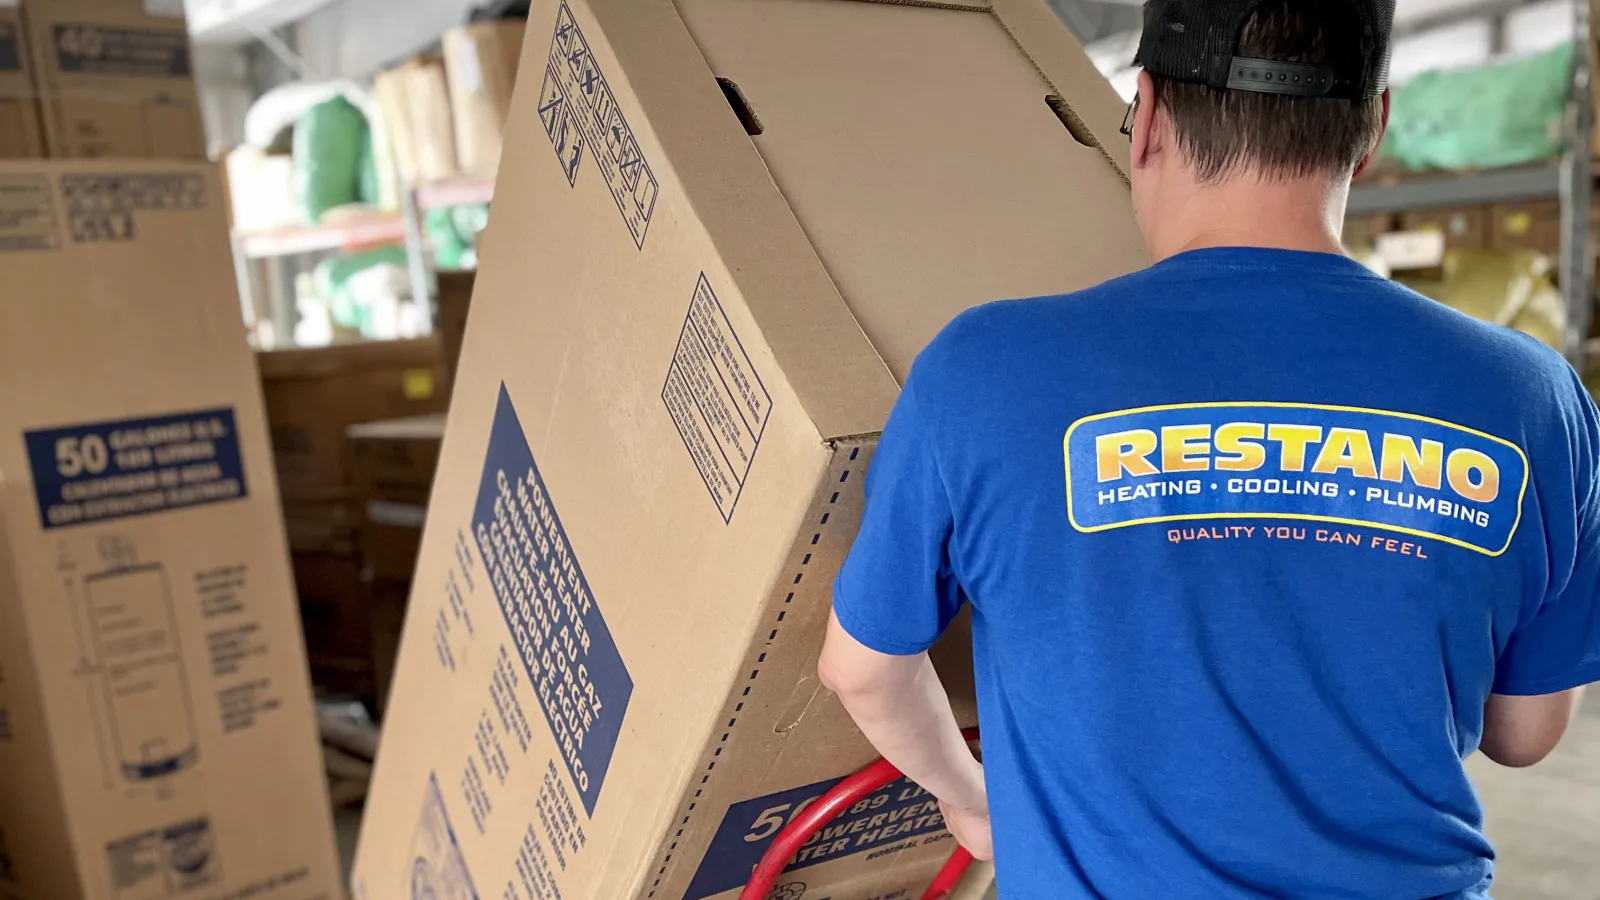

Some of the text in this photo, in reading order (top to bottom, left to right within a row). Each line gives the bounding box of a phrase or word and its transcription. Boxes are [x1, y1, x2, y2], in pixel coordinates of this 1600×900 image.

[54, 433, 109, 477] 50
[1095, 422, 1499, 503] RESTANO
[527, 468, 591, 615] POWERVENT
[1098, 479, 1489, 527] HEATING COOLING PLUMBING
[1167, 526, 1428, 559] QUALITY YOU CAN FEEL
[498, 470, 602, 719] CHAUFFE-EAU AU GAZ
[517, 478, 590, 656] WATER HEATER
[491, 522, 542, 653] CALENTADOR
[542, 648, 556, 684] DE
[555, 683, 583, 750] AGUA
[494, 497, 551, 639] ÉVACUATION
[551, 636, 592, 732] FORCÉE
[478, 523, 495, 569] CON
[493, 565, 540, 681] EXTRACTOR
[539, 677, 588, 792] ÉLECTRICO
[544, 773, 579, 854] COSTADO EN
[548, 758, 586, 848] NO ESTIBE DE
[804, 800, 939, 846] OWERVEN
[855, 814, 945, 846] HEATE
[898, 786, 931, 801] LI
[536, 799, 566, 871] POSTERIOR
[866, 833, 953, 860] NOMINAL CAPA
